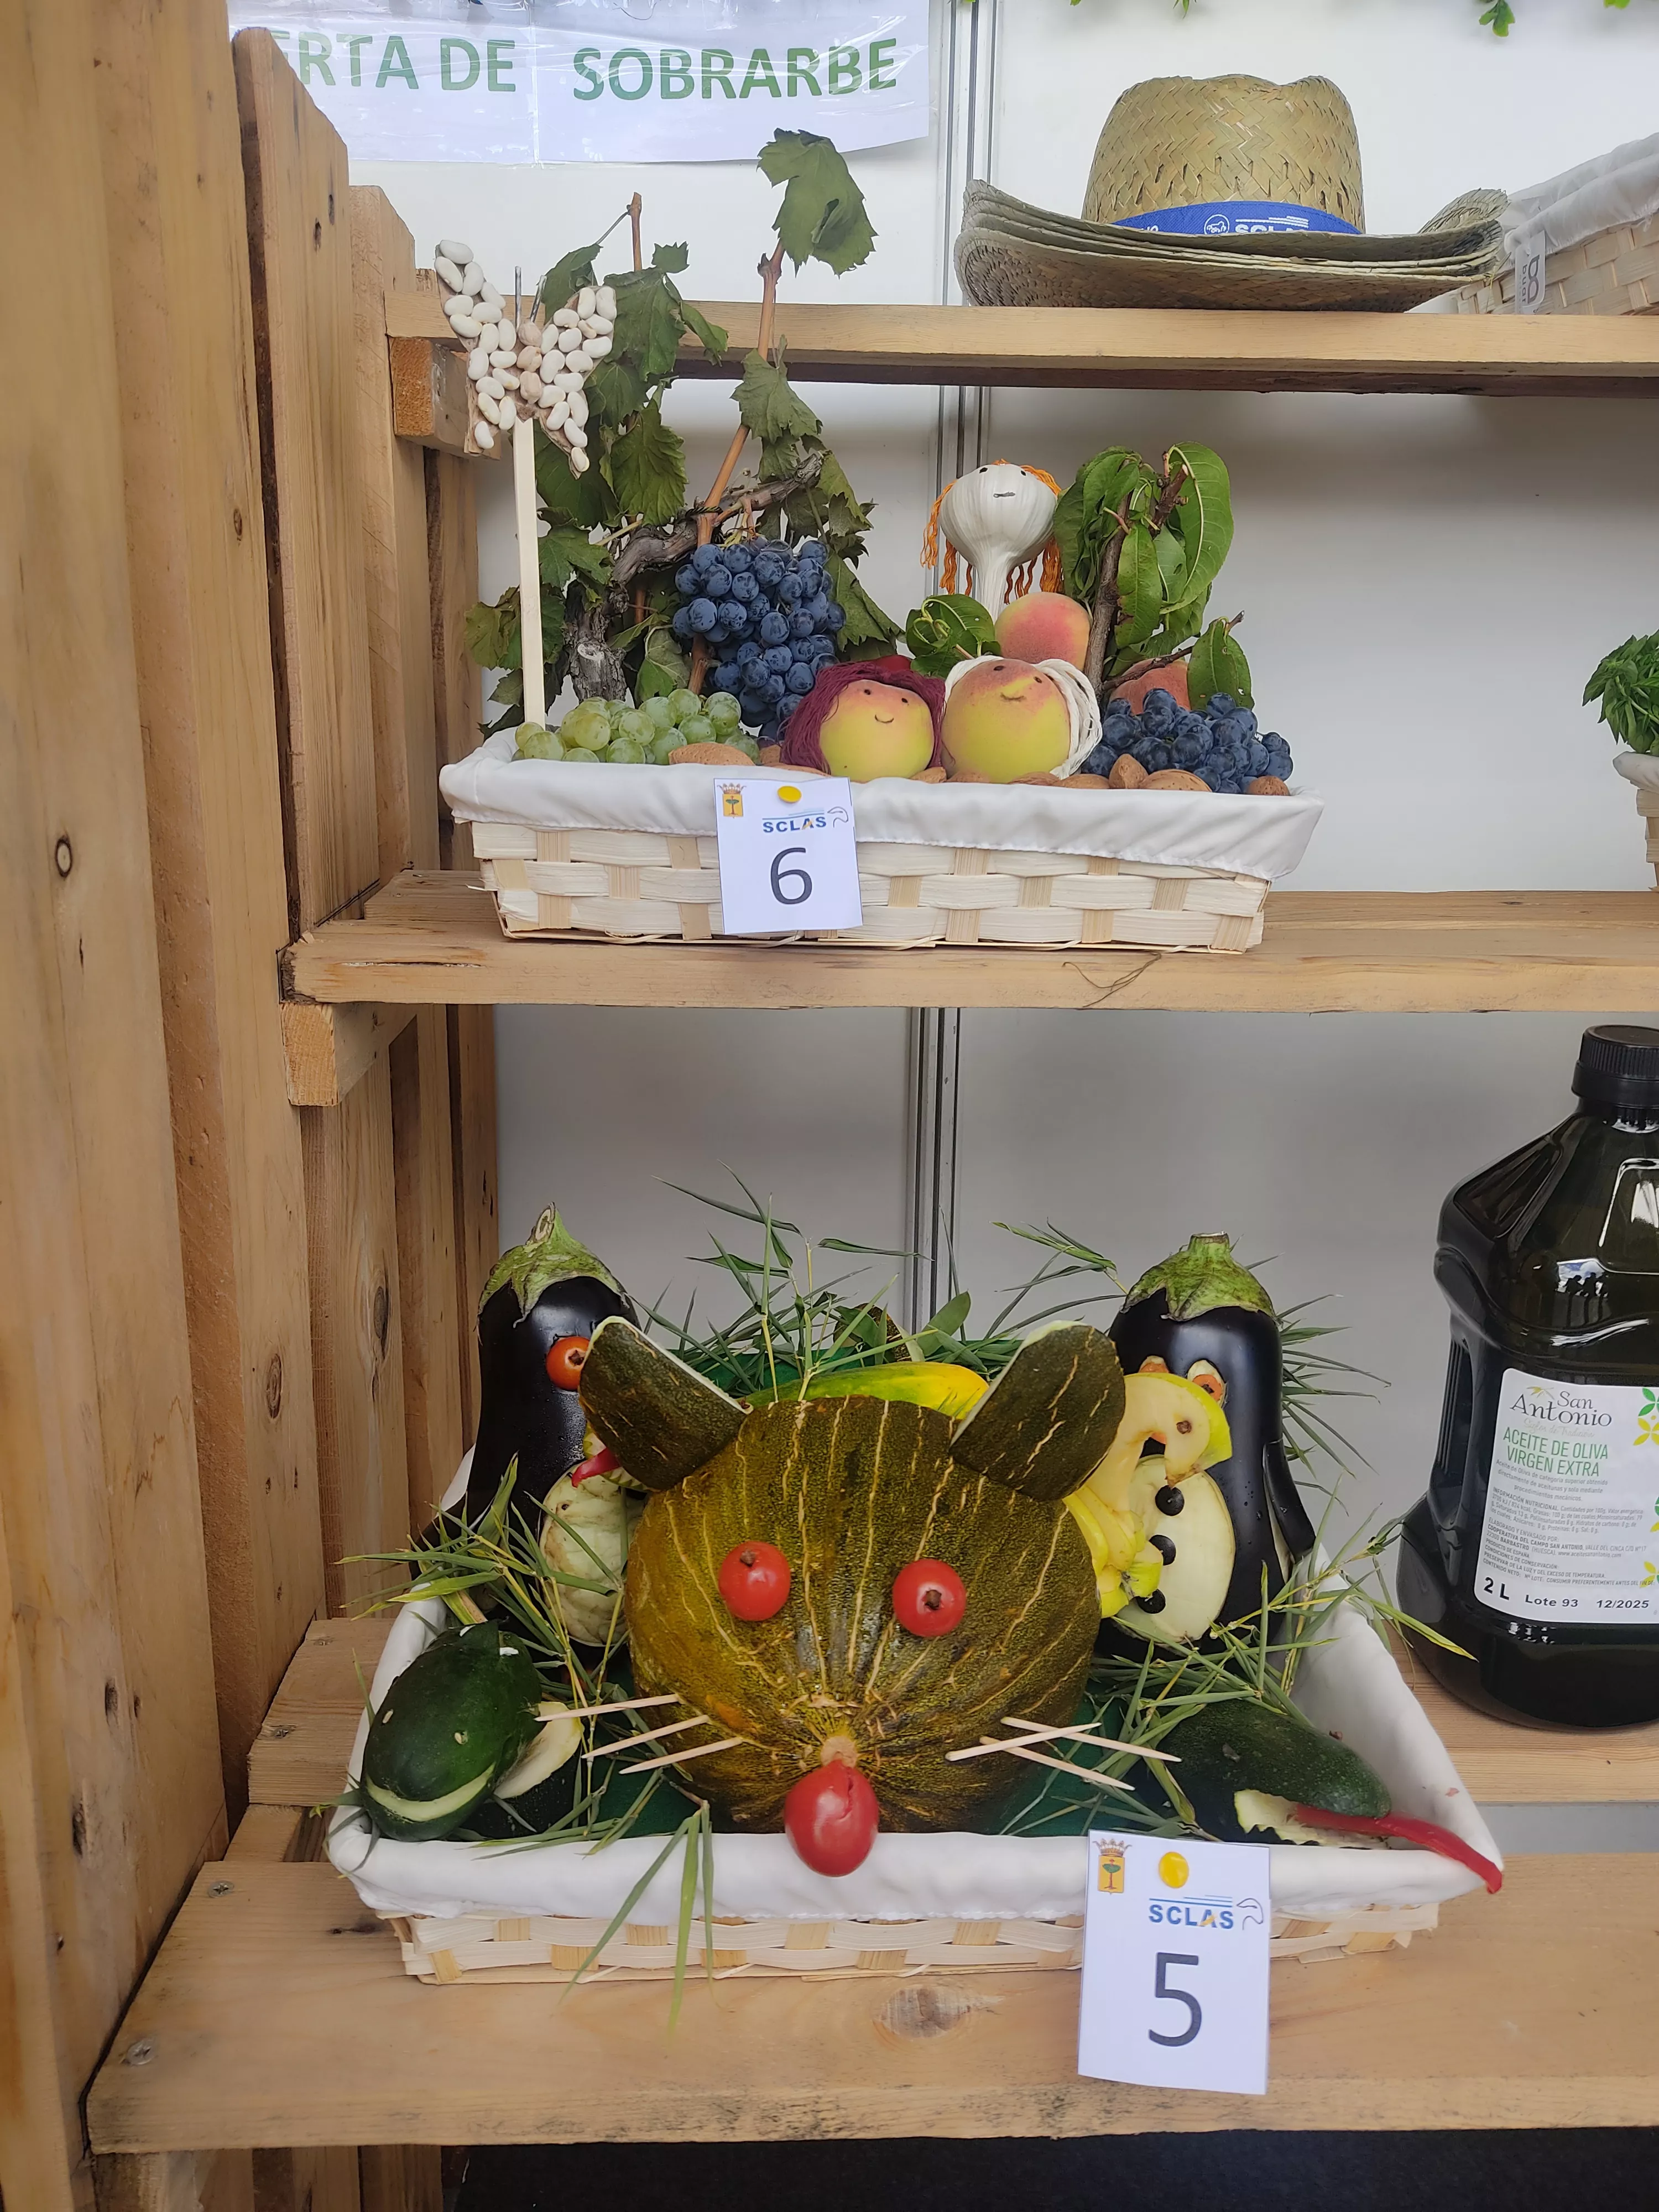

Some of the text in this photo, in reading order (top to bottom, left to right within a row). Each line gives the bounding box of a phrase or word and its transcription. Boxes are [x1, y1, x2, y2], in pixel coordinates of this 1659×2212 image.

[440, 38, 516, 92] DE
[572, 38, 898, 101] SOBRARBE
[763, 816, 827, 833] SCLAS
[770, 847, 812, 905] 6
[1510, 1394, 1612, 1426] Antonio
[1557, 1391, 1593, 1409] San
[1503, 1427, 1608, 1459] ACEITE DE OLIVA
[1496, 1459, 1510, 1469] Aceite
[1518, 1467, 1531, 1476] Oliva
[1507, 1445, 1599, 1477] VIRGEN EXTRA
[1498, 1469, 1528, 1484] directamente
[1538, 1483, 1563, 1491] aceitunas
[1514, 1485, 1553, 1499] procedimientos
[1488, 1524, 1518, 1541] COOPERATIVA
[1530, 1540, 1548, 1548] CAMPO
[1489, 1517, 1515, 1532] ELABORADO
[1520, 1530, 1546, 1541] ENVASADO
[1485, 1545, 1513, 1560] CONDICIONES
[1486, 1538, 1506, 1551] PRODUCTO
[1500, 1537, 1529, 1551] BARBASTRO
[1483, 1558, 1507, 1572] CONTENIDO
[1484, 1551, 1509, 1565] PRESERVAR
[1483, 1577, 1650, 1608] 2 L Lote 93 12/2025
[1149, 1903, 1234, 1929] SCLAS
[1149, 1952, 1202, 2047] 5
